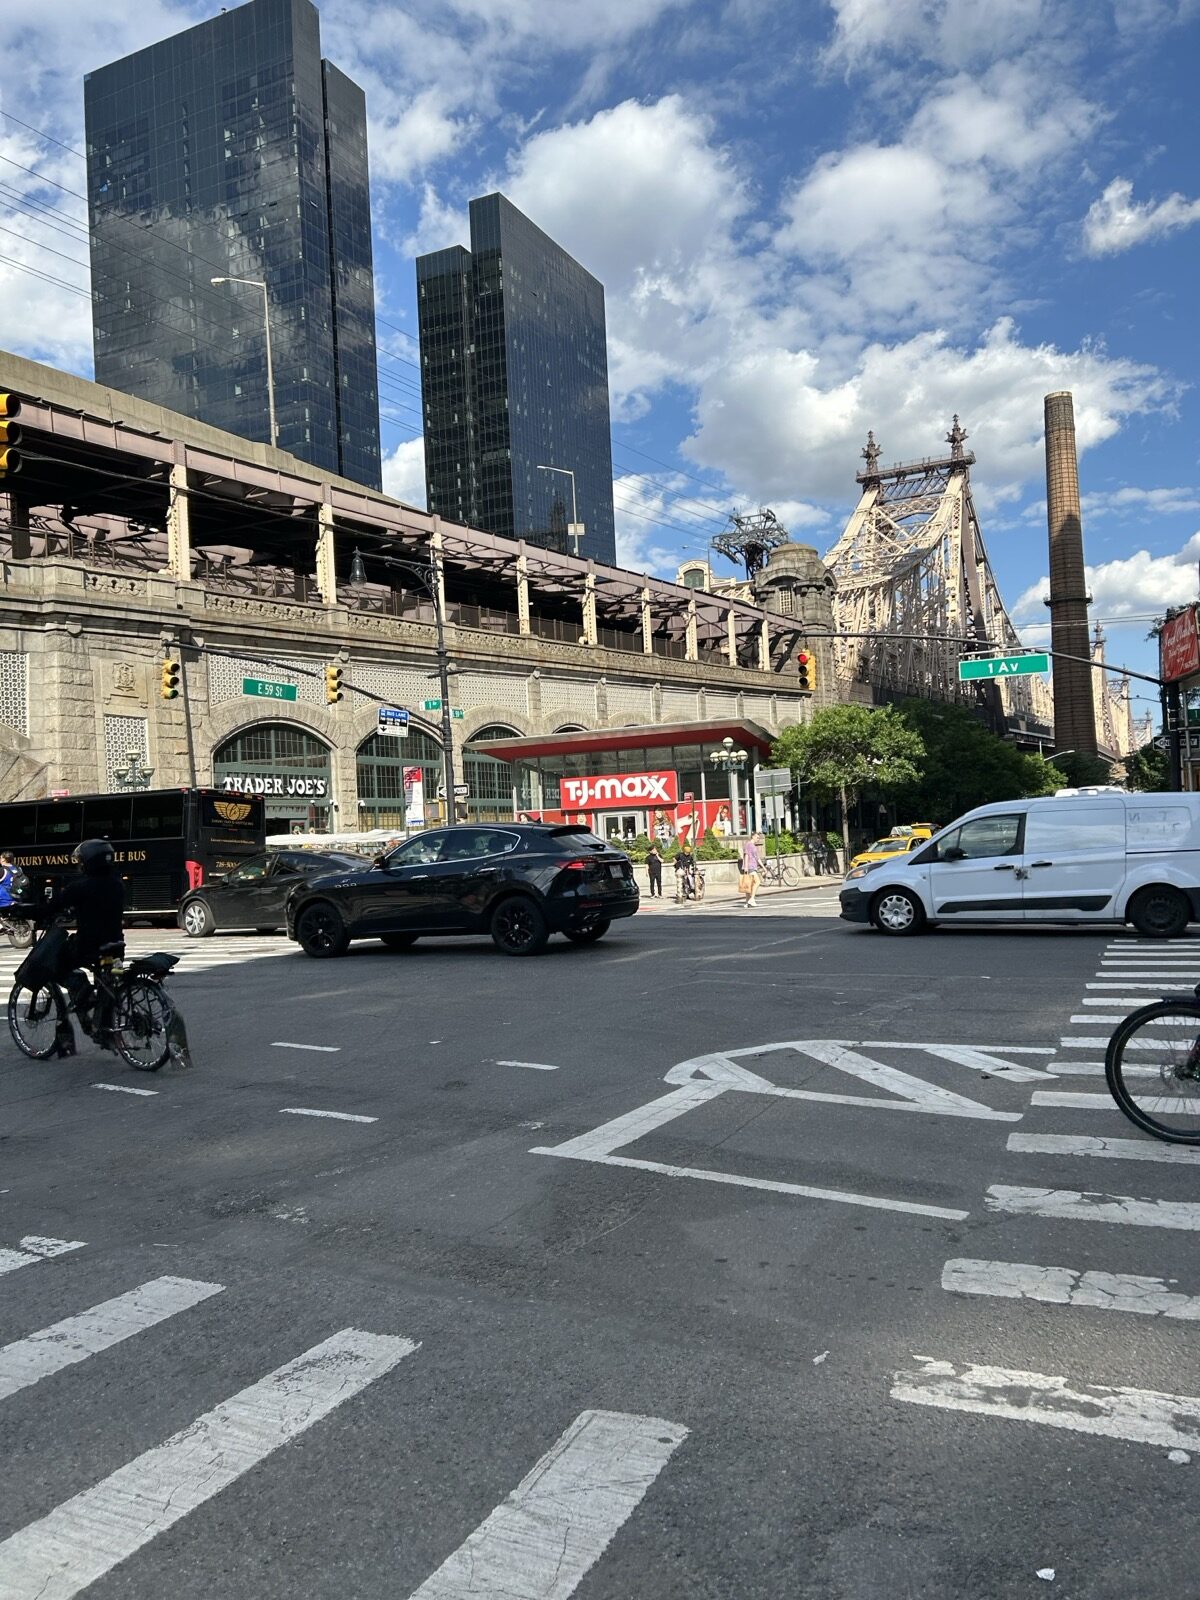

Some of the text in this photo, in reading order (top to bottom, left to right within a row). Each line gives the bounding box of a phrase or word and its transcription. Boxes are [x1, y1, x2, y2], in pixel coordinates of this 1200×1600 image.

[988, 661, 1019, 674] 1 Av
[257, 682, 283, 697] E 59 St
[222, 776, 326, 795] TRADER JOE'S
[13, 855, 44, 867] UXURY
[45, 854, 69, 865] VANS
[127, 850, 146, 862] BUS
